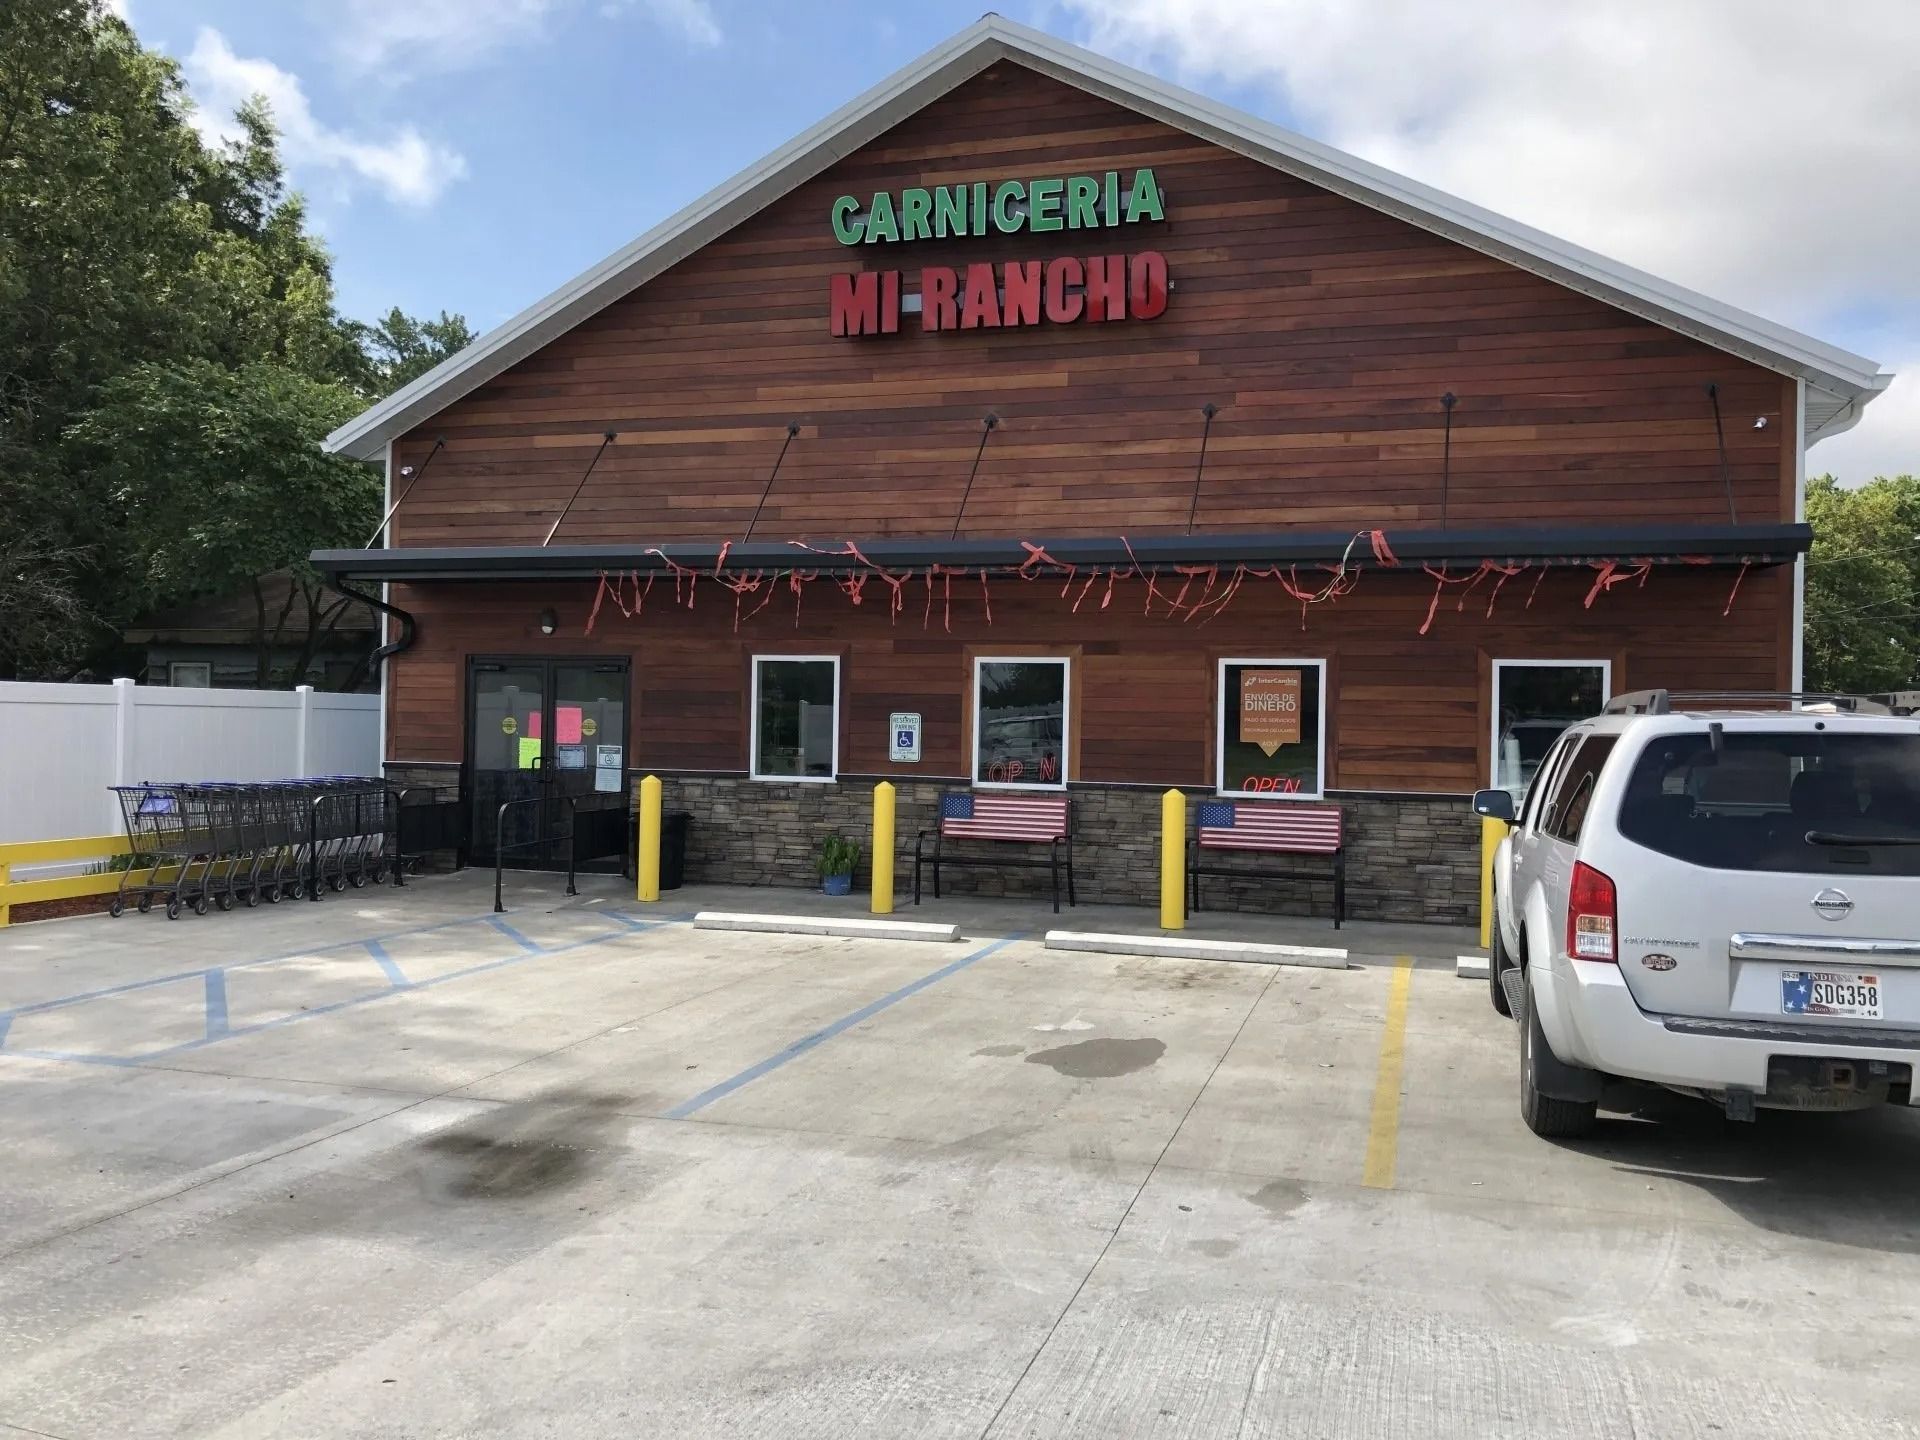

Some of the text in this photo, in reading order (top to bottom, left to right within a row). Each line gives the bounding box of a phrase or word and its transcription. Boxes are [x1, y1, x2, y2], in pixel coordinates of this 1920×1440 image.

[831, 168, 1165, 246] CARNICERIA
[830, 251, 1168, 337] MI RANCHO
[1244, 691, 1296, 702] ENVÍOS DE
[1244, 701, 1296, 712] DINERO
[1814, 900, 1851, 908] NISSAN
[1807, 972, 1854, 983] INDIANA
[1814, 983, 1878, 1007] SDG358
[1866, 1009, 1878, 1017] 14
